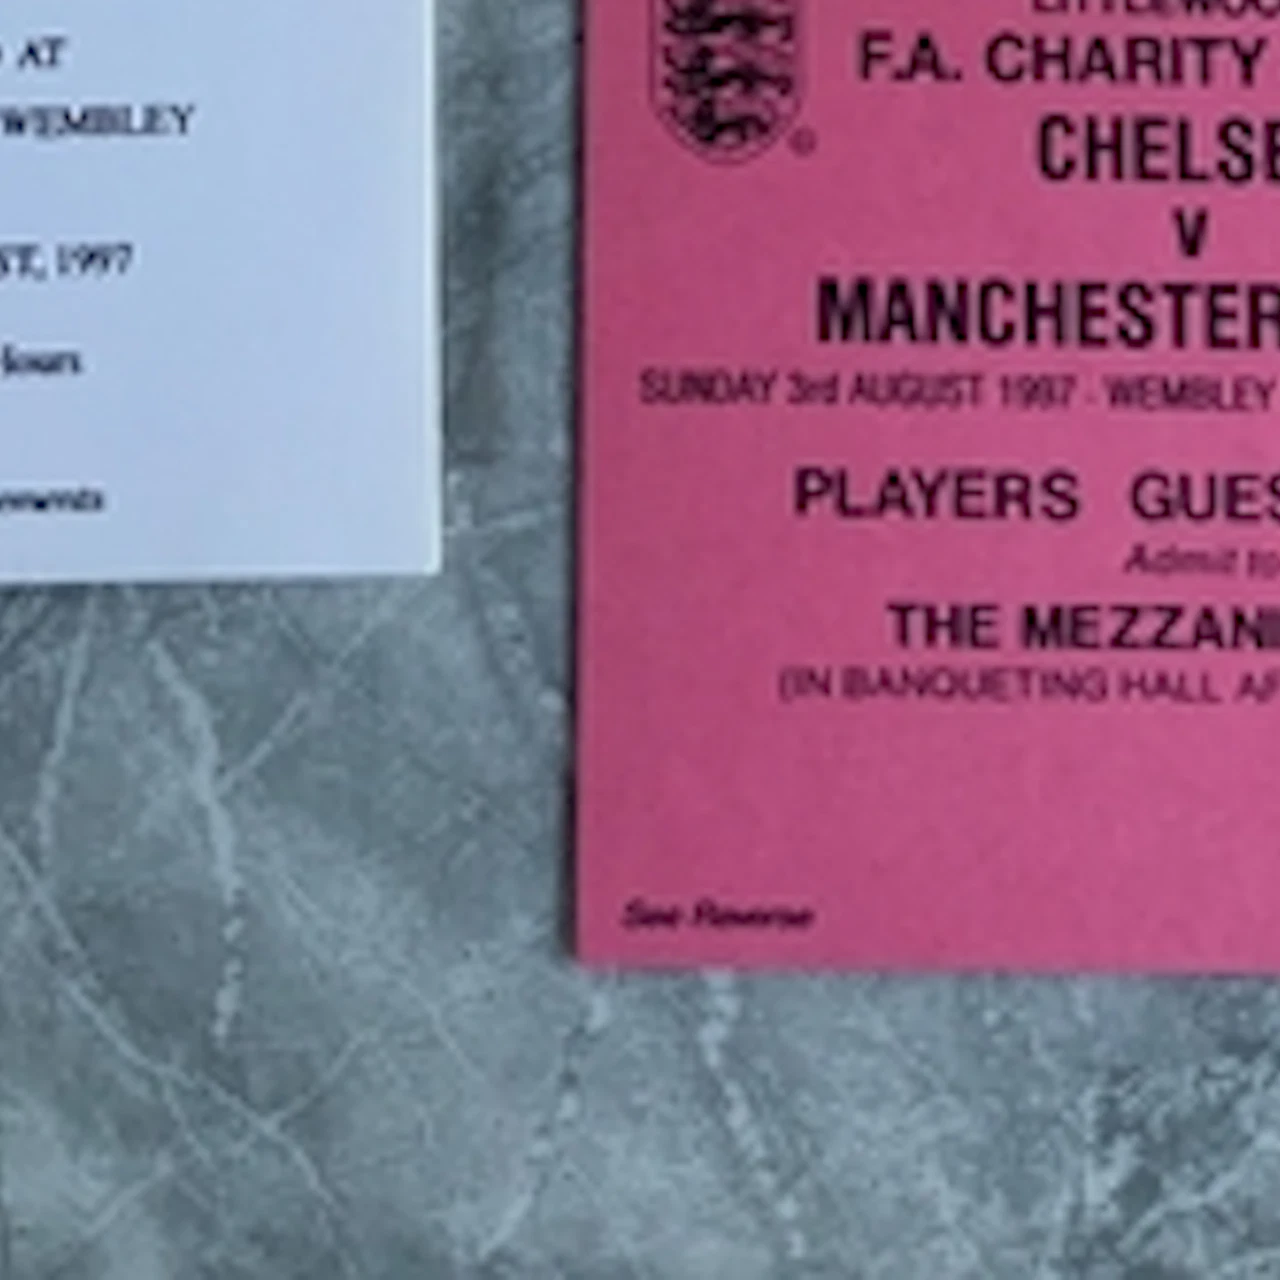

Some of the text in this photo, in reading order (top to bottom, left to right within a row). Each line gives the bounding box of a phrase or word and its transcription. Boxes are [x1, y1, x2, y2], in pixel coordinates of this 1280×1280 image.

[17, 36, 65, 69] AT
[858, 29, 962, 82] F.A.
[984, 31, 1268, 87] CHARITY
[57, 242, 133, 275] 1997
[639, 368, 777, 405] SUNDAY
[786, 369, 841, 406] 3rd
[847, 370, 985, 409] AUGUST
[999, 373, 1077, 410] 1997
[1105, 374, 1276, 412] WEMBLEY
[794, 466, 1081, 522] PLAYERS
[1123, 542, 1238, 577] Admit
[886, 602, 999, 650] THE
[778, 667, 833, 701] (IN
[840, 665, 1109, 703] BANQUETING
[1118, 670, 1222, 705] HALL
[622, 898, 815, 930] See Reverse
